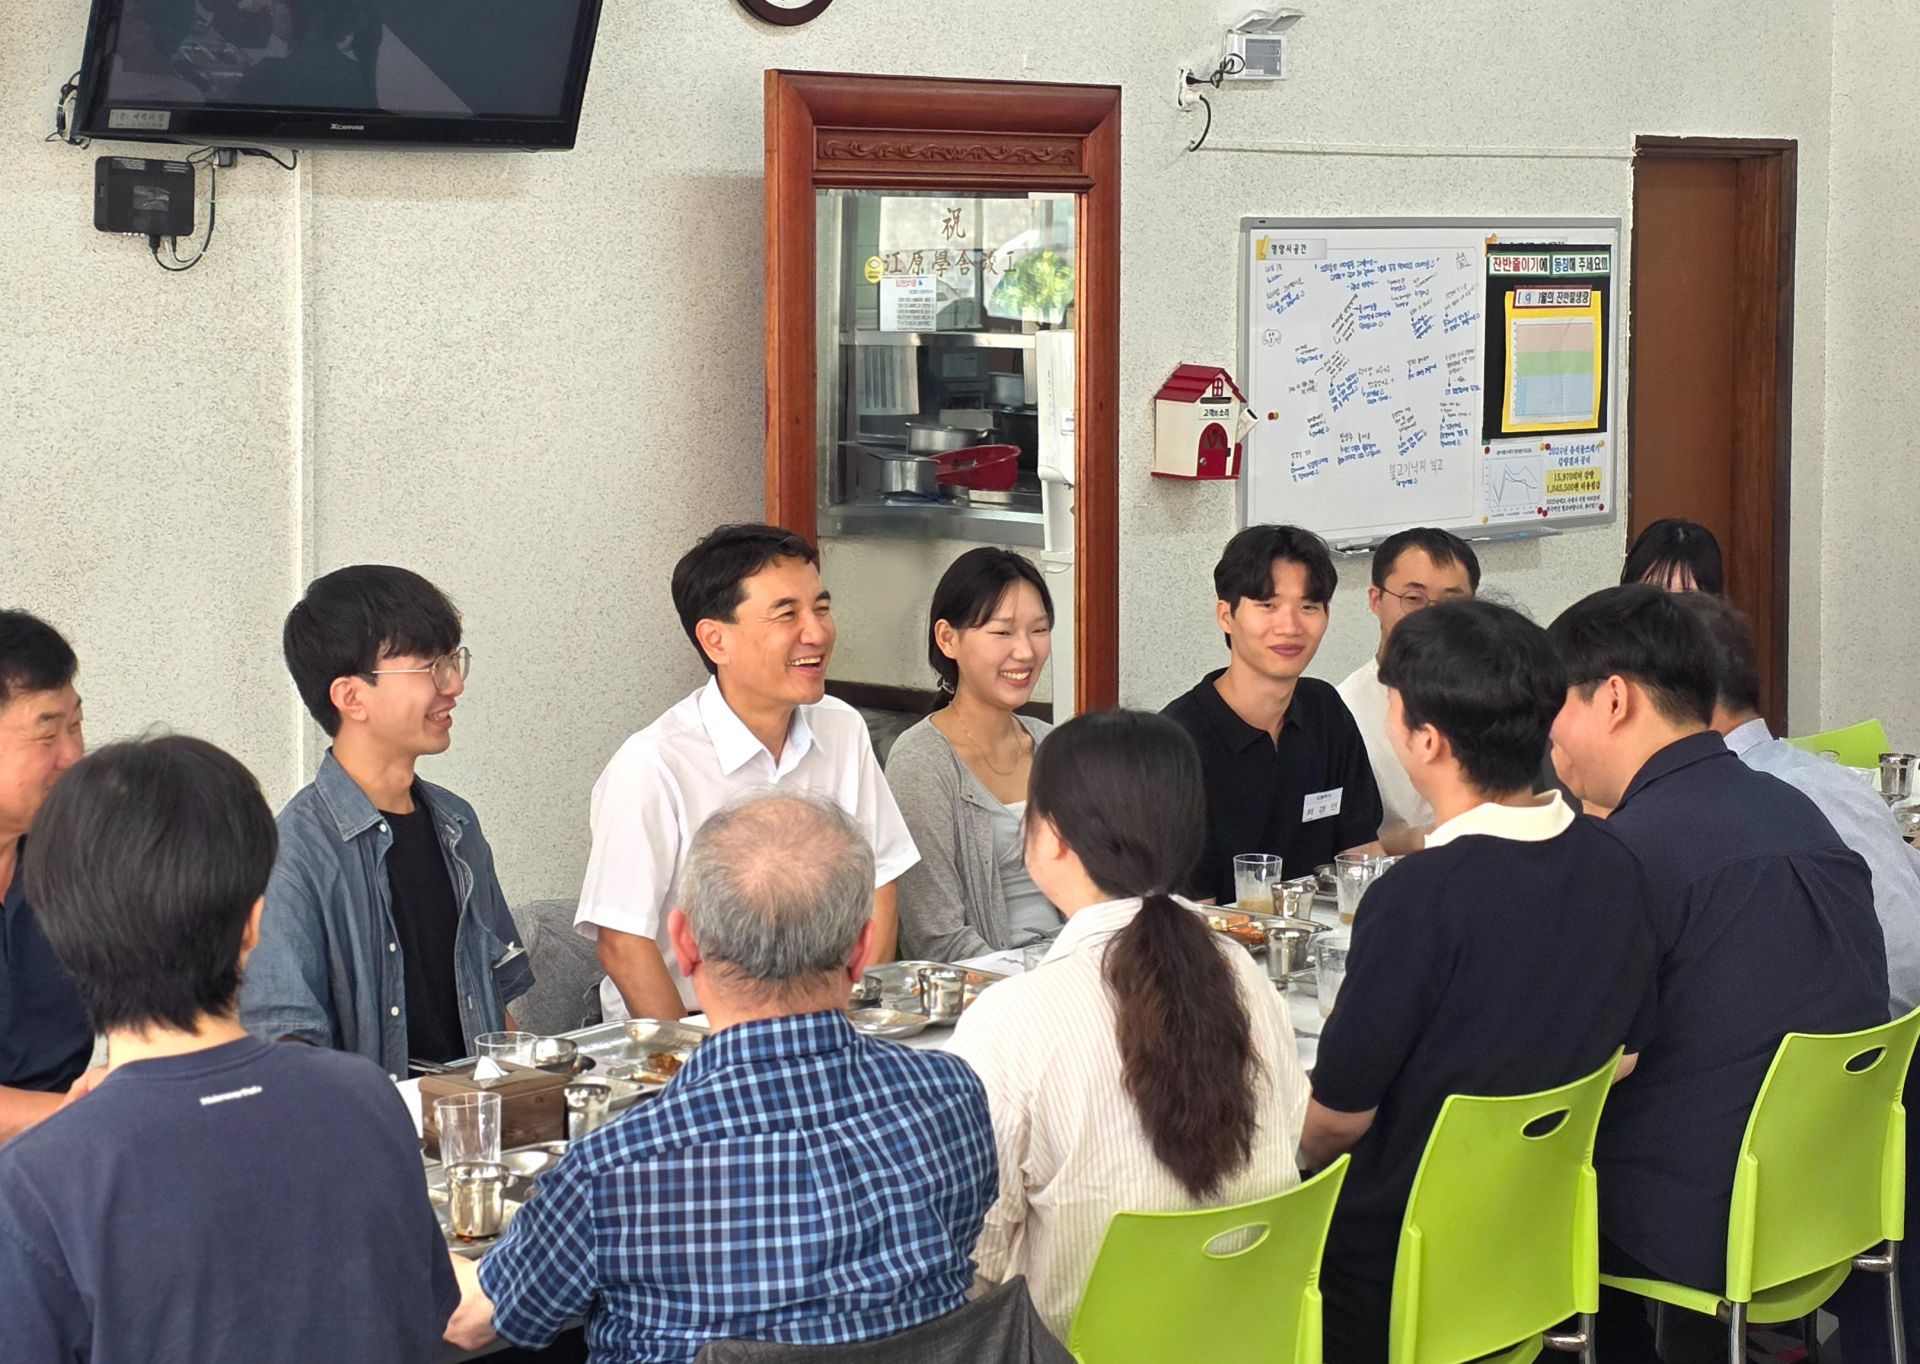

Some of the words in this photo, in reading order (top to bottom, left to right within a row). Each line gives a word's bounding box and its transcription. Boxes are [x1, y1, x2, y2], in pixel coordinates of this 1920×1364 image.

[941, 207, 966, 241] 祝
[1271, 244, 1307, 255] 영양사공간
[1493, 256, 1548, 272] 잔반줄이기에
[1554, 257, 1576, 273] 동참해
